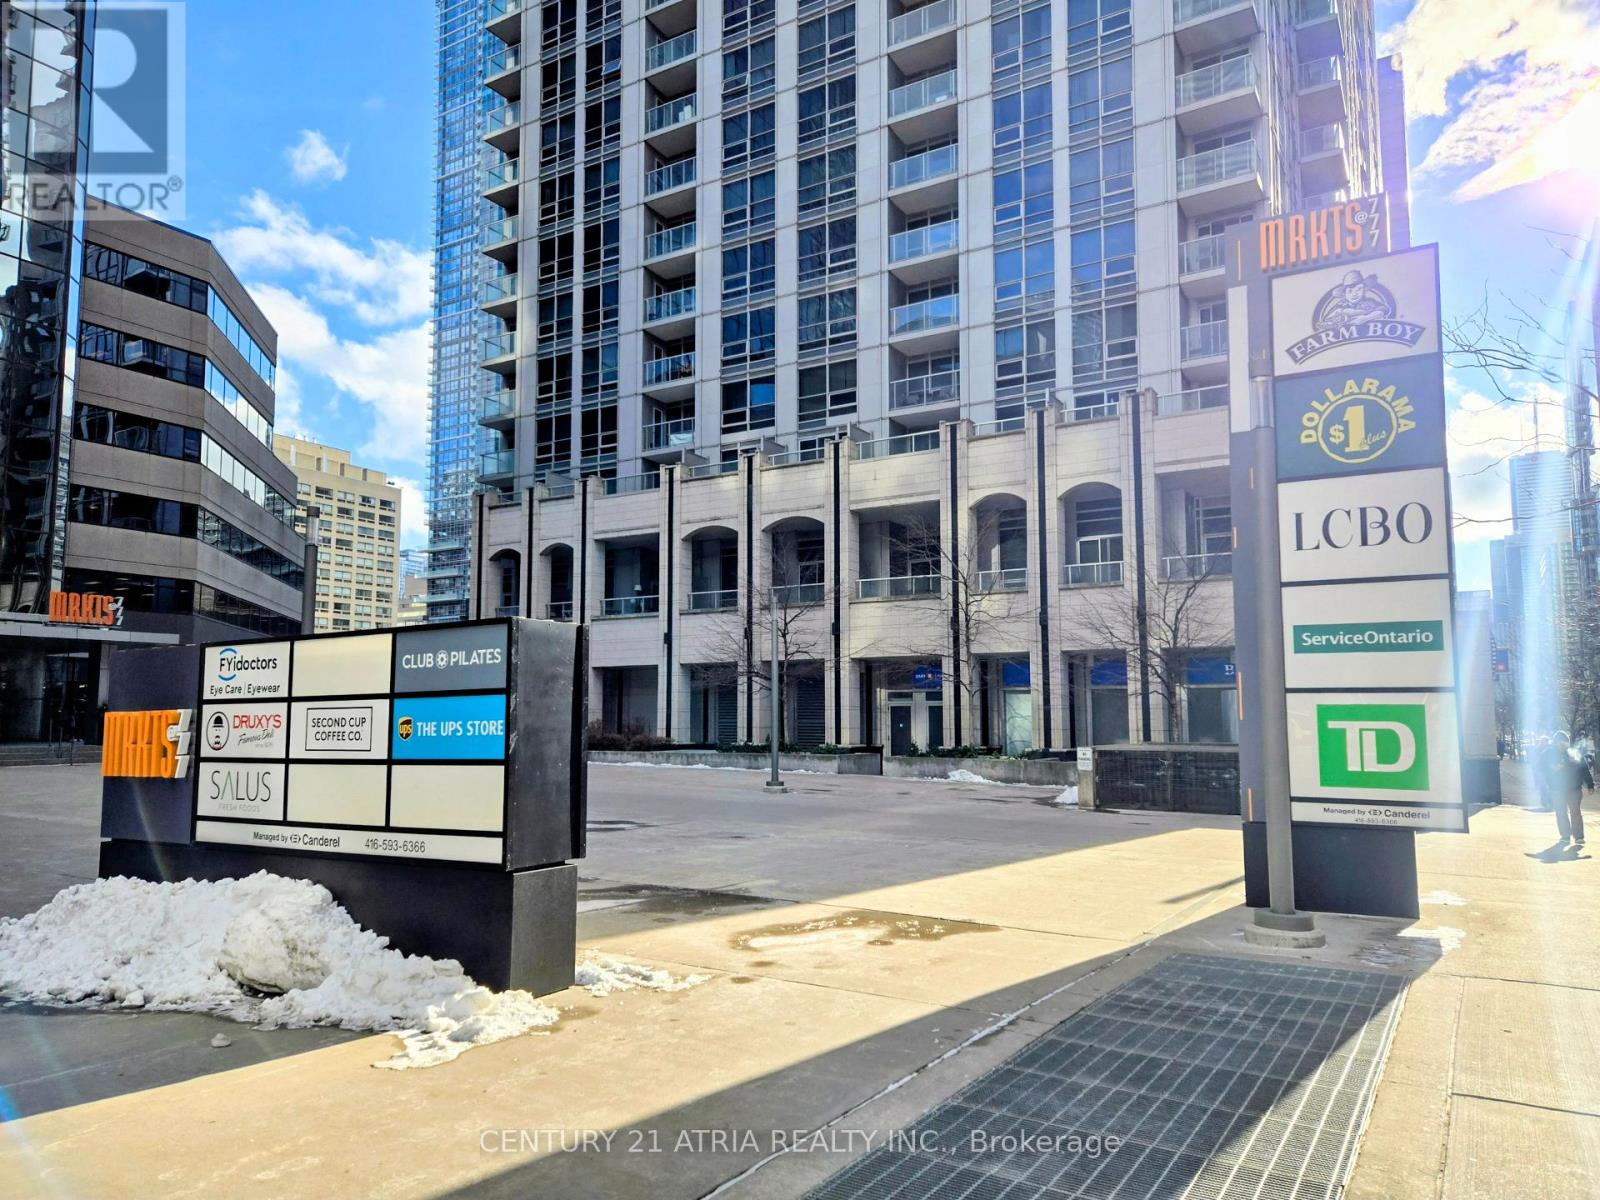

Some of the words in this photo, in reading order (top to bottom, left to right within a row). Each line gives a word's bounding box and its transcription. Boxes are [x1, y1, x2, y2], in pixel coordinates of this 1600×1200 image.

[1260, 203, 1363, 272] MRKTS
[1293, 325, 1357, 358] FARM
[1367, 321, 1421, 340] BOY
[1300, 377, 1416, 444] DOLLARAMA
[1293, 502, 1432, 551] LCBO
[49, 592, 114, 624] MRKTS
[1301, 629, 1433, 646] ServiceOntario
[219, 655, 278, 671] FYidoctors
[402, 653, 434, 669] CLUB
[449, 648, 502, 667] PILATES
[210, 684, 223, 697] Eye
[225, 683, 243, 695] Care
[247, 682, 280, 696] Eyewear
[311, 717, 345, 729] SECOND
[347, 717, 367, 728] CUP
[416, 722, 437, 737] THE
[439, 721, 463, 737] UPS
[466, 719, 504, 736] STORE
[102, 710, 180, 778] MRKTS
[314, 731, 345, 742] COFFEE
[1327, 720, 1416, 773] TD
[210, 771, 271, 802] SALUS
[1323, 807, 1356, 815] Managed
[1384, 809, 1431, 819] Canderel
[253, 831, 280, 843] Managed
[281, 832, 289, 843] by
[302, 833, 340, 848] Canderel
[364, 838, 426, 853] 416-593-6366
